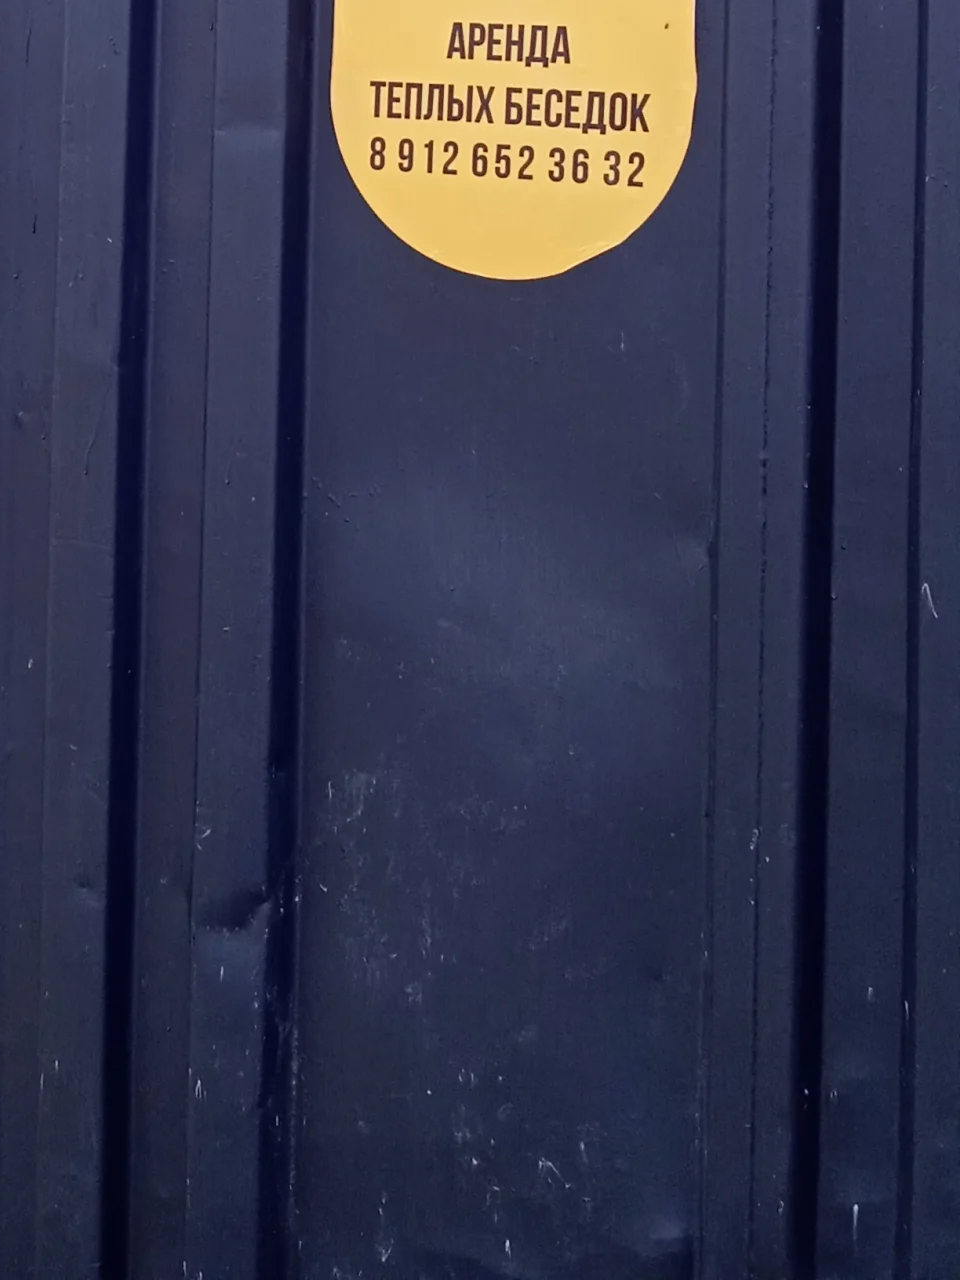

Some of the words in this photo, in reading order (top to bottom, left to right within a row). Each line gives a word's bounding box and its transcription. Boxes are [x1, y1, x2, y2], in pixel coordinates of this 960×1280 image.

[446, 21, 571, 68] АРЕНДА
[369, 80, 496, 125] ТЕПЛЫХ
[504, 86, 651, 136] БЕСЕДОК
[369, 136, 387, 171] 8
[397, 138, 460, 176] 912
[471, 142, 535, 181] 652
[548, 147, 590, 184] 36
[603, 150, 646, 188] 32
